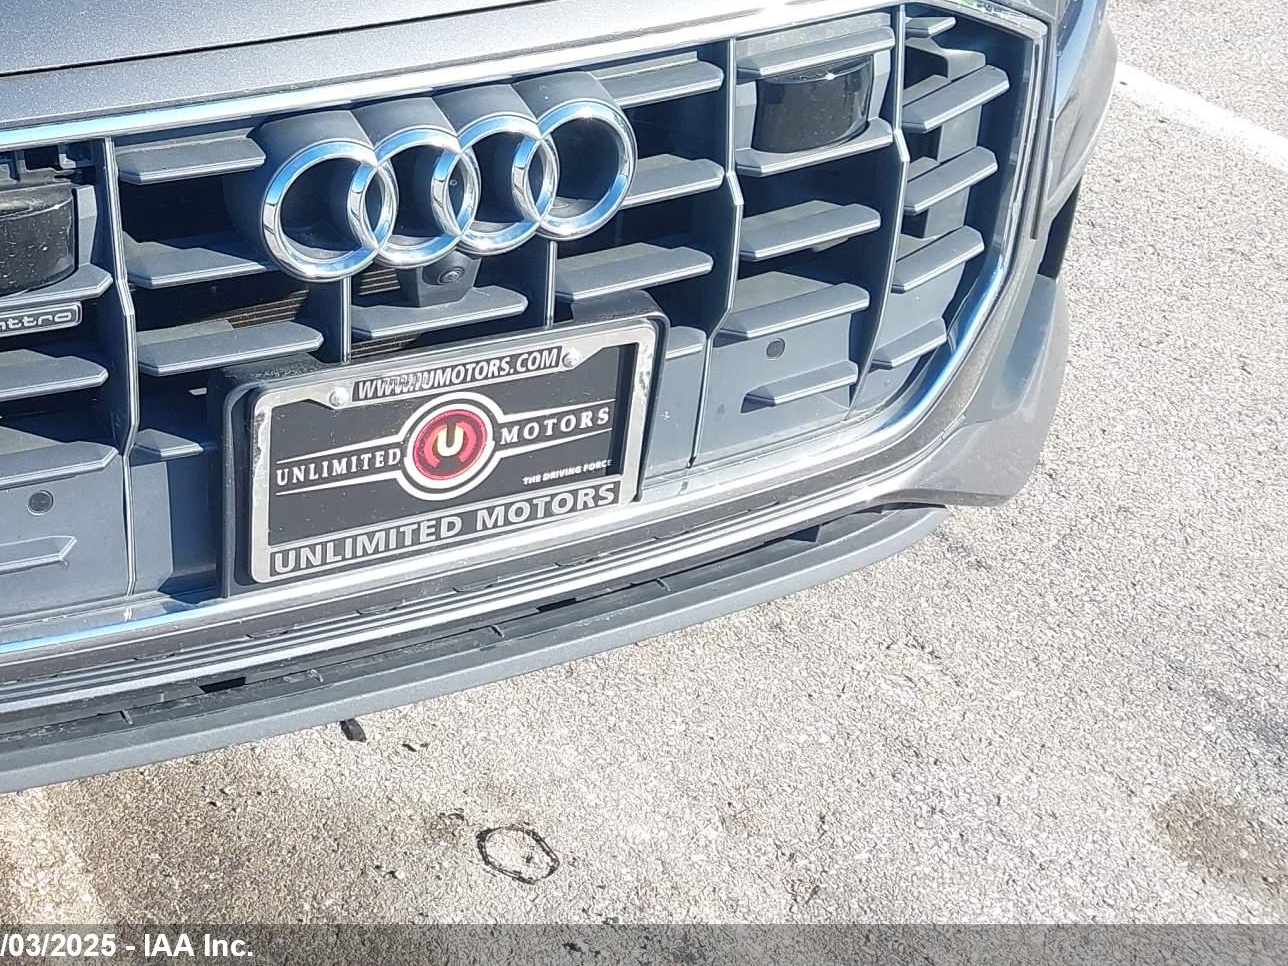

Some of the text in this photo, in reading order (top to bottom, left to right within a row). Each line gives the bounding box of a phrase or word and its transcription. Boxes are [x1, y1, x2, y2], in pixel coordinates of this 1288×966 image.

[276, 407, 610, 485] UNLIMITED U MOTORS
[522, 459, 613, 485] THE DRIVING FORCE
[274, 483, 615, 574] UNLIMITED MOTORS
